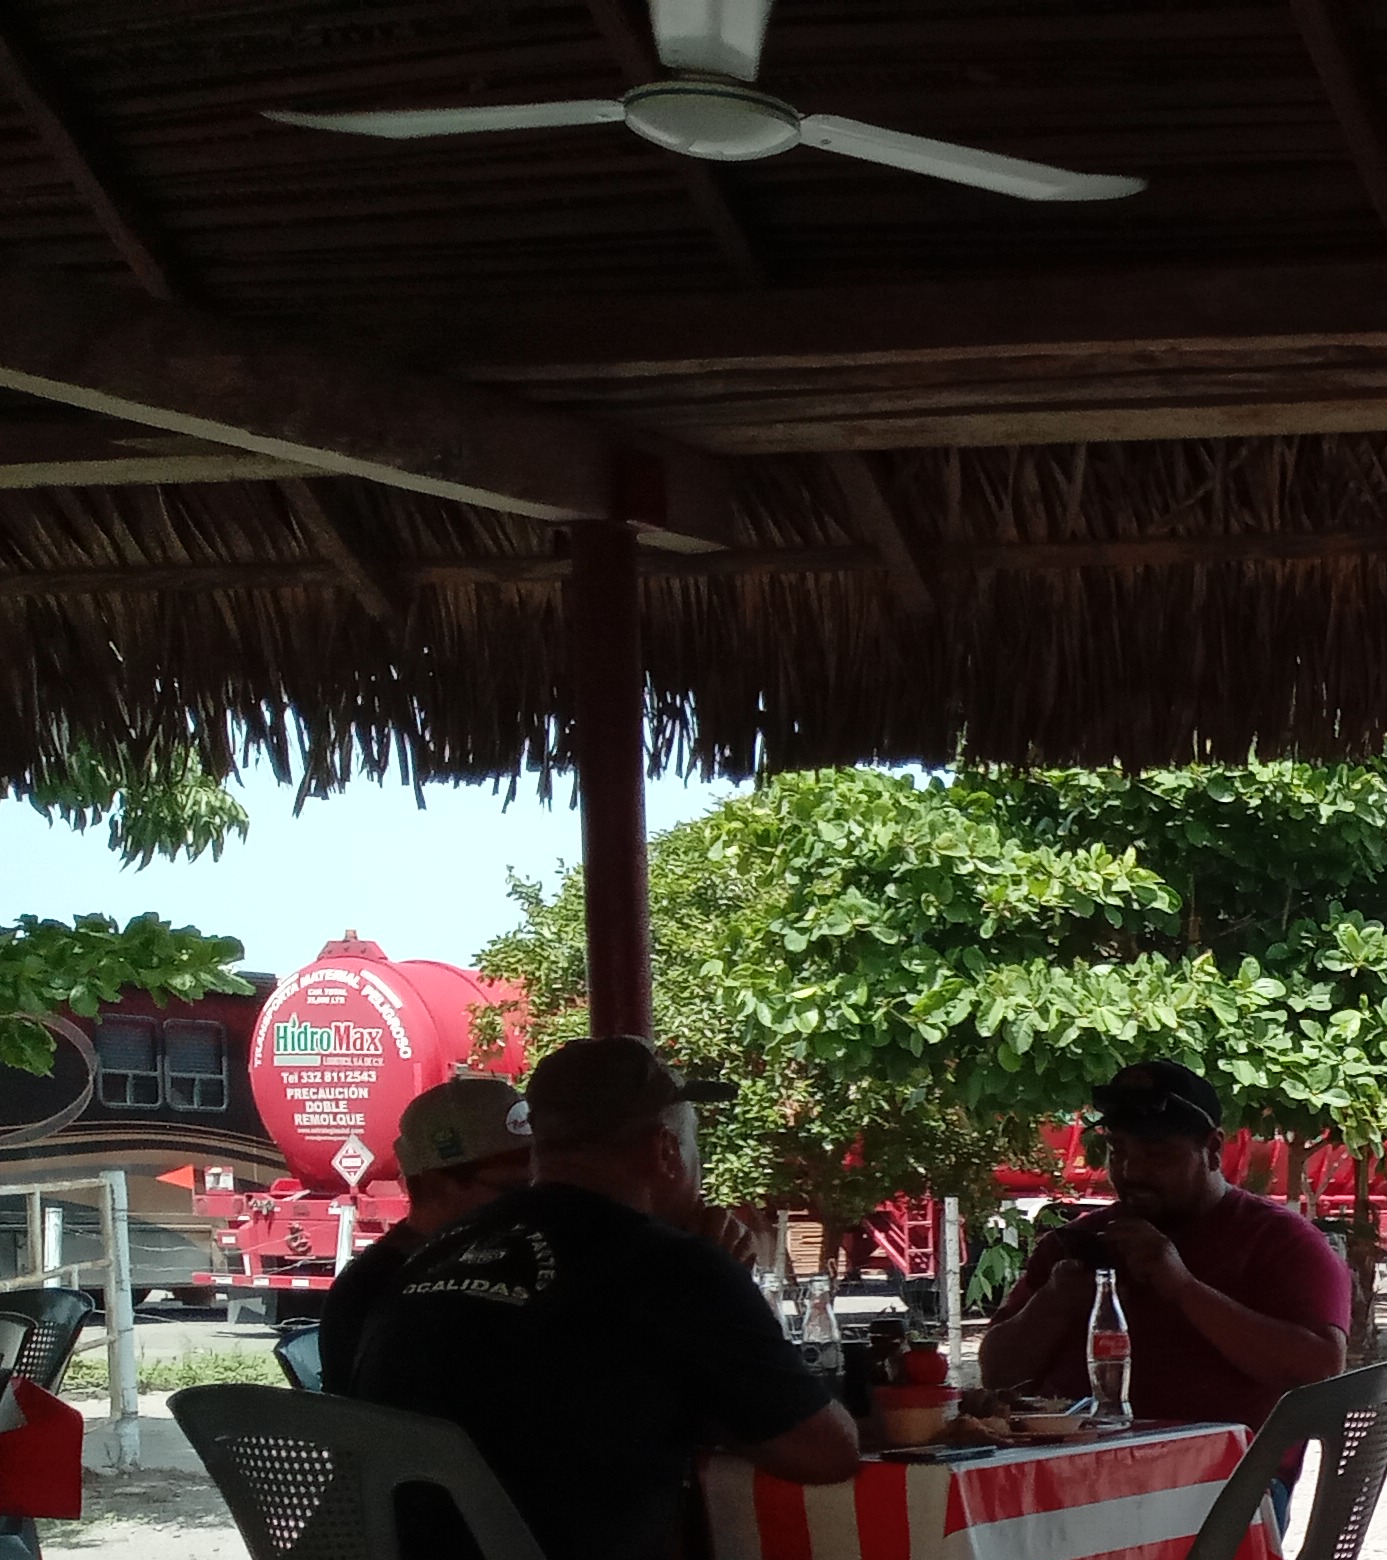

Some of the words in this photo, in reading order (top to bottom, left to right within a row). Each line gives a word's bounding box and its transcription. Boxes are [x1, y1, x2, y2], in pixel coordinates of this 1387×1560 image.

[254, 982, 300, 1067] TRANSPORTA
[300, 968, 360, 990] MATERIAL
[361, 983, 412, 1059] PELIGROSO
[274, 1013, 382, 1055] HidroMax
[300, 1070, 322, 1083] 332
[286, 1084, 369, 1100] PRECAUCIÓN
[305, 1100, 349, 1113] DOBLE
[294, 1113, 366, 1126] REMOLQUE
